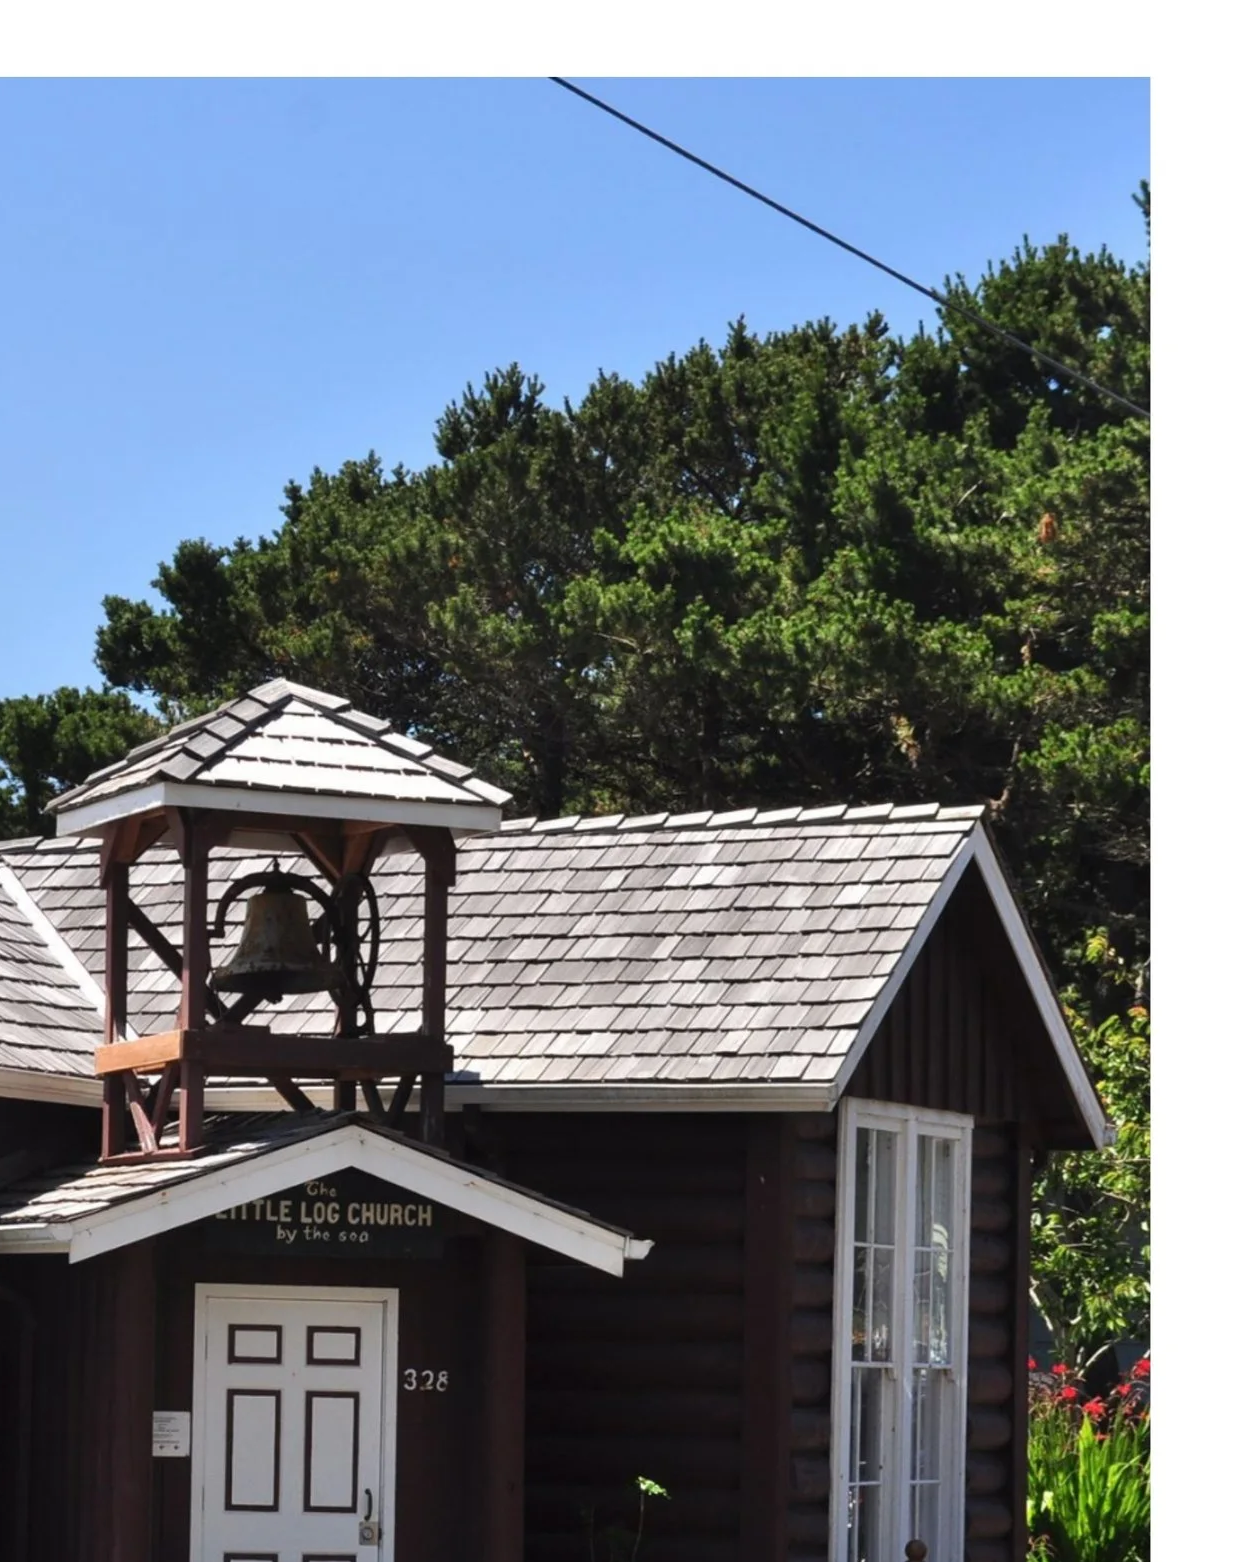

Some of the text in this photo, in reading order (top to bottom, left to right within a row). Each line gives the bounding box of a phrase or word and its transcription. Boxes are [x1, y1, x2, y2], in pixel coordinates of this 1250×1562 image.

[306, 1181, 337, 1198] The
[300, 1202, 340, 1224] LOG
[347, 1203, 433, 1226] CHURCH
[276, 1225, 369, 1244] by the sea
[403, 1368, 449, 1392] 328
